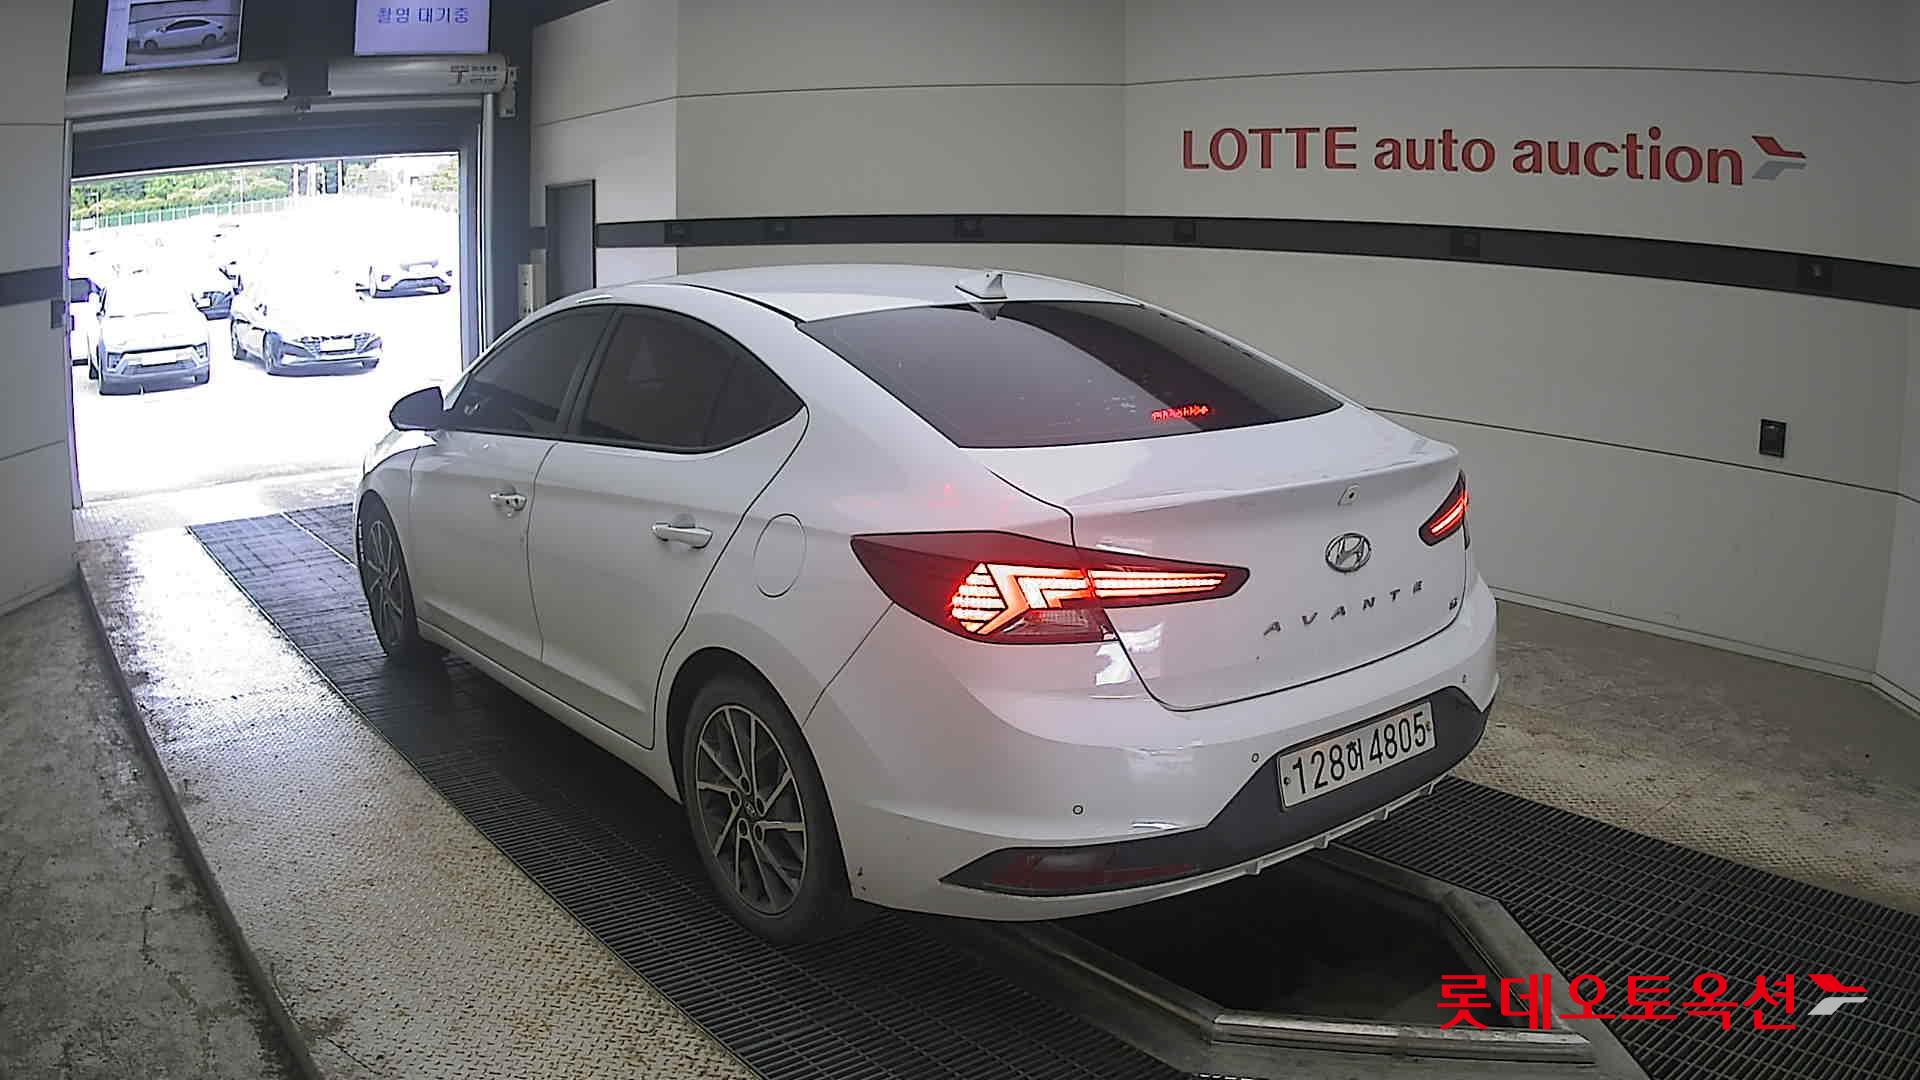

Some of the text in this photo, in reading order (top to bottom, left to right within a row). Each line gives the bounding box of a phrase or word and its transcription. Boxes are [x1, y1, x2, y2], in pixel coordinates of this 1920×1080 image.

[418, 7, 471, 24] 대기중
[1182, 126, 1744, 186] LOTTE auto auction
[1263, 580, 1423, 636] AVANTE
